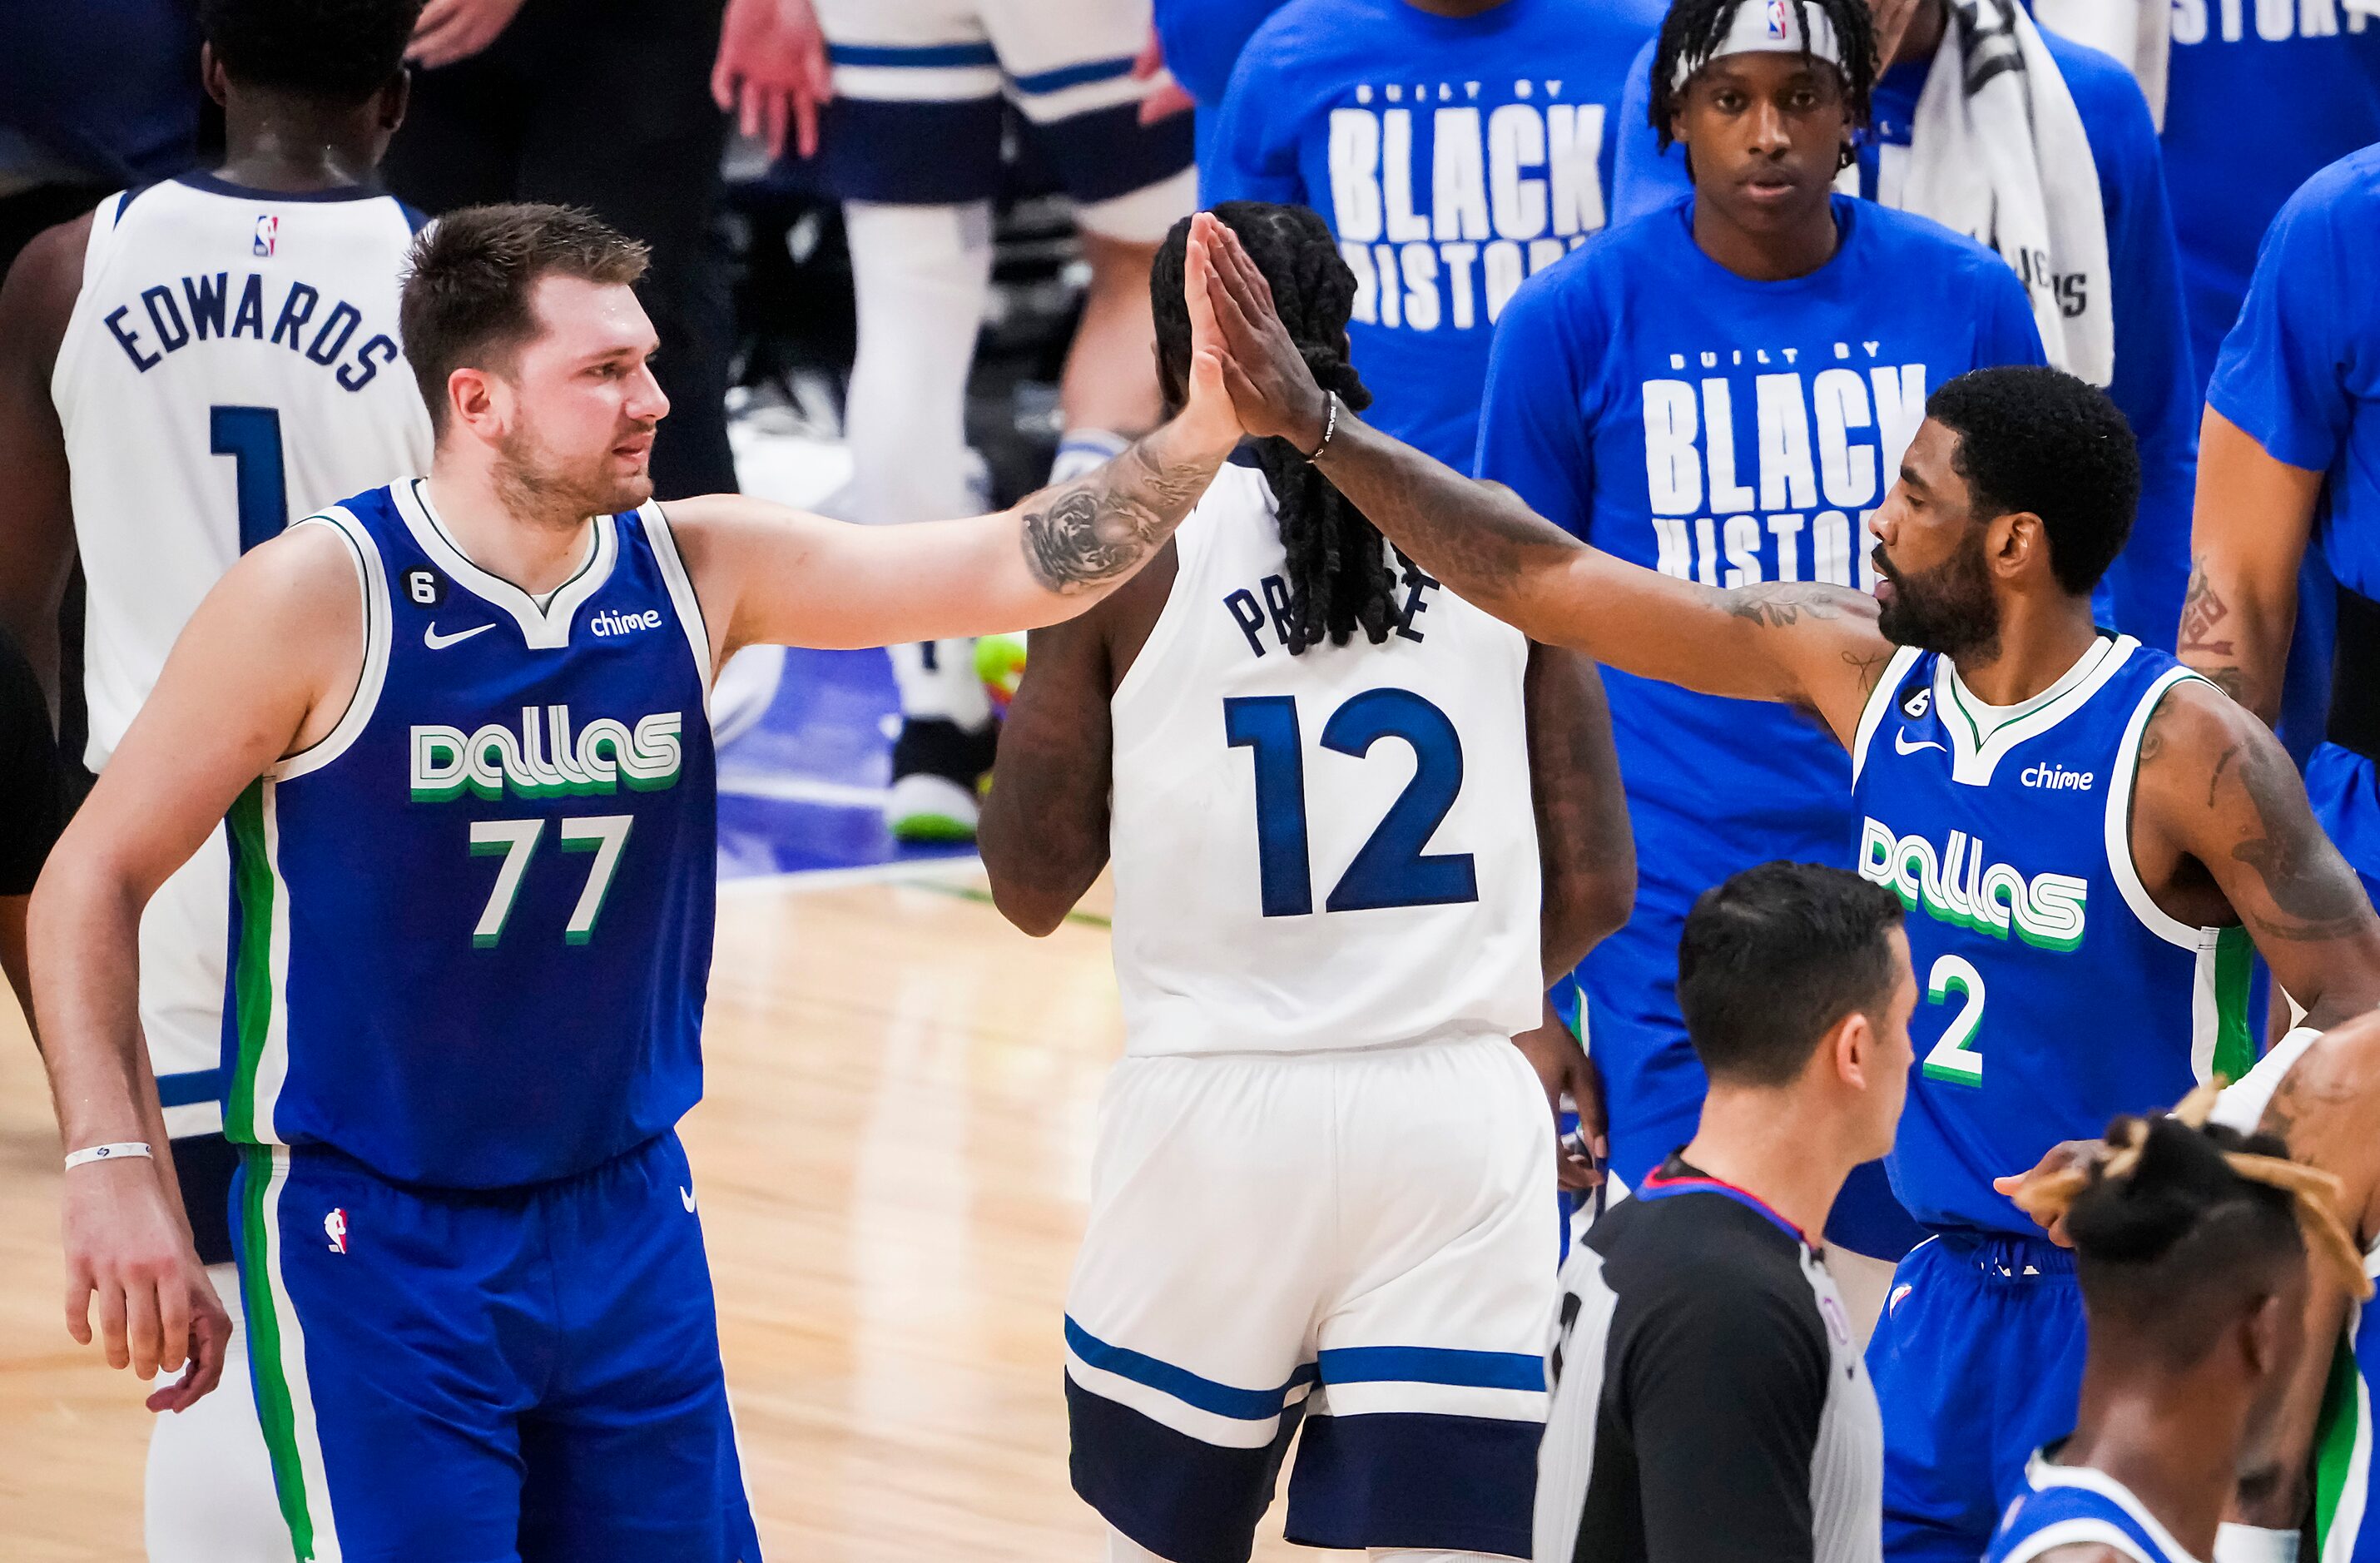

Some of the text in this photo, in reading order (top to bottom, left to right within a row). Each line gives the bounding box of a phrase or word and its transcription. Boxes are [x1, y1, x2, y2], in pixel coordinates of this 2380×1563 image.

[1329, 104, 1606, 242] BLACK
[104, 272, 398, 392] EDWARDS
[1339, 235, 1586, 332] HISTO
[1669, 341, 1880, 370] BUILT BY
[210, 405, 289, 558] 1
[410, 572, 436, 603] 6
[590, 609, 662, 637] chime
[1223, 573, 1441, 658] PRE
[1904, 687, 1931, 717] 6
[410, 704, 682, 802] Dallas
[1223, 687, 1479, 917] 12
[2021, 762, 2094, 791] chime
[469, 815, 634, 948] 77
[1858, 816, 2087, 952] Dallas
[1922, 954, 1986, 1088] 2
